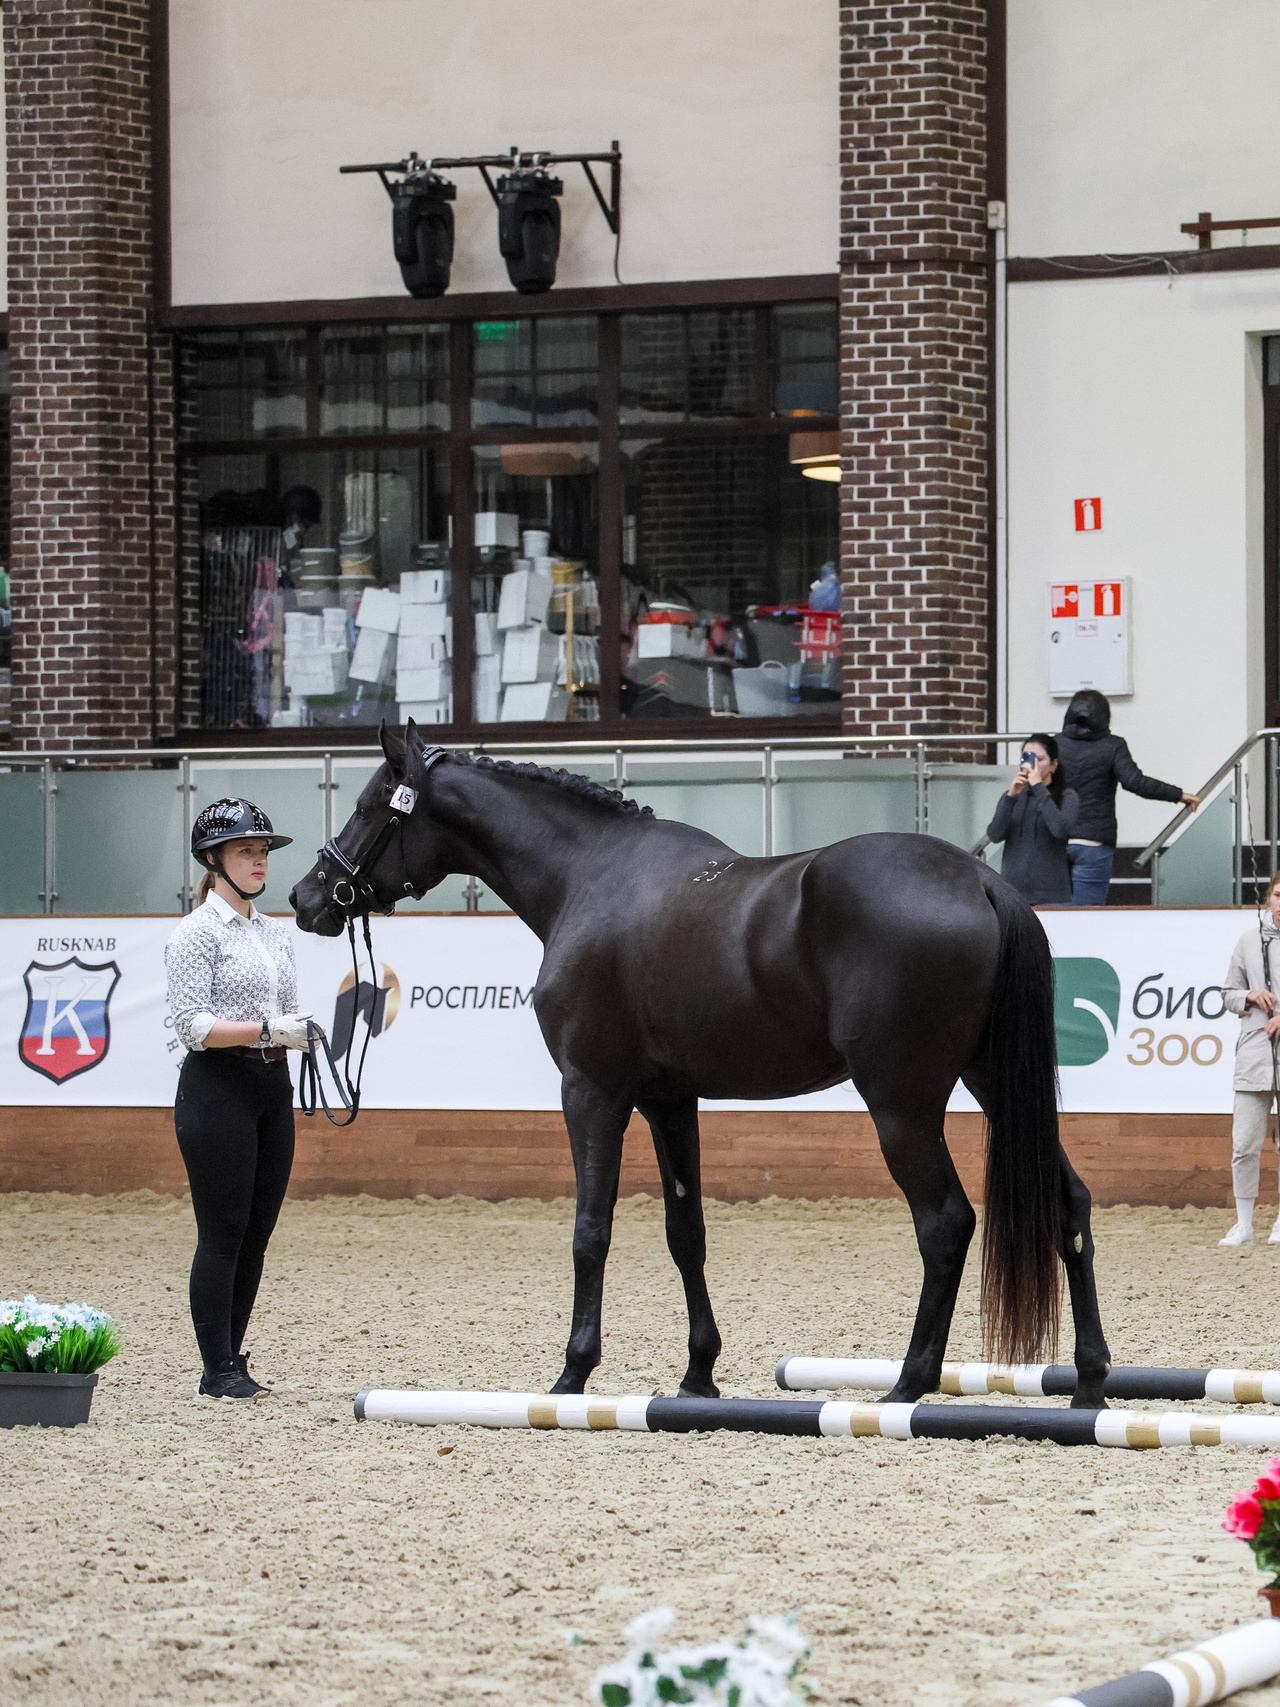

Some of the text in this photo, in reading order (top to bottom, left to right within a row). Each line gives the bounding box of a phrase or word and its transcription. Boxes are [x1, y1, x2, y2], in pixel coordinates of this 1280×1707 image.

[397, 792, 412, 804] 15
[36, 937, 117, 952] RUSKNAB
[410, 986, 535, 1009] РОСПЛЕМ
[1132, 972, 1227, 1019] био
